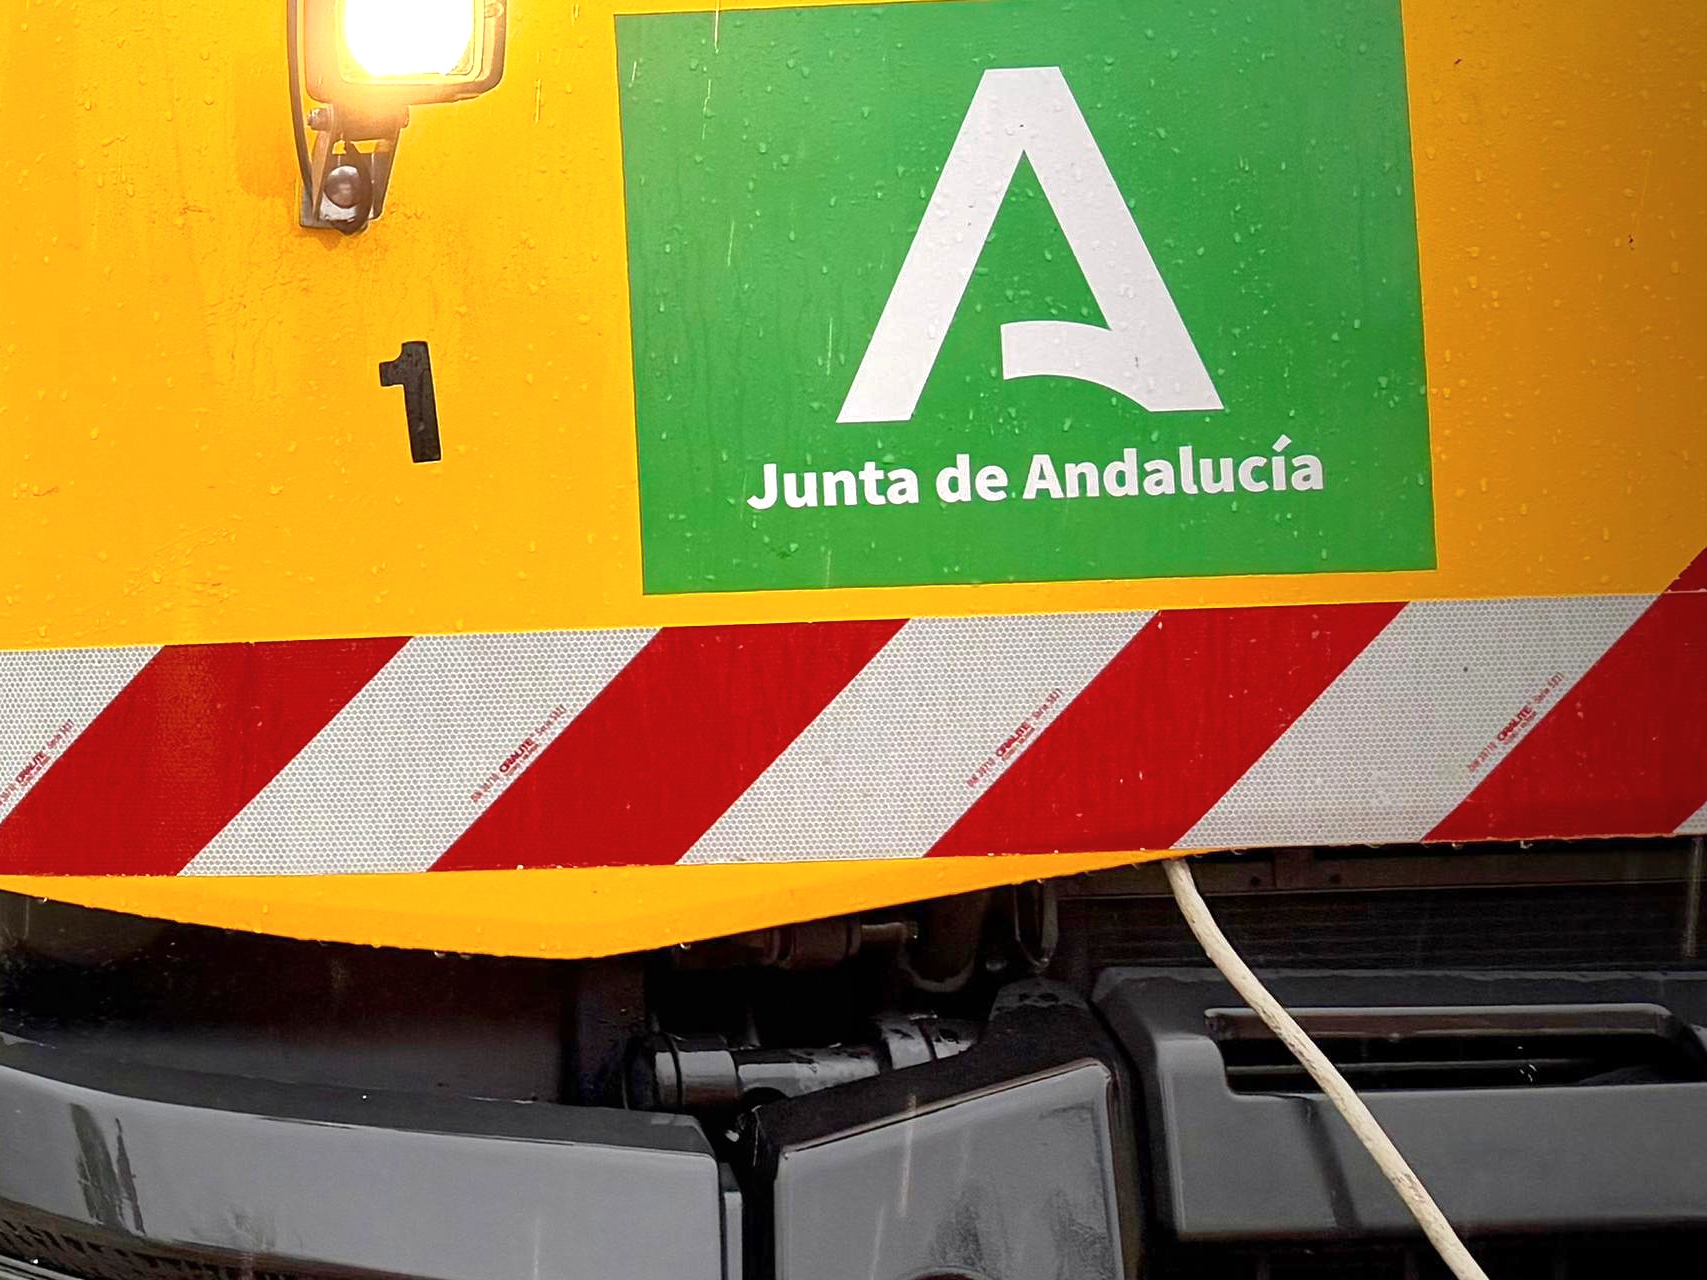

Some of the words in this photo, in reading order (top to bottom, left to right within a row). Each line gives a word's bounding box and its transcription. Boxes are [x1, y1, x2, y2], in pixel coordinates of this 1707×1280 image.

[378, 340, 441, 463] 1
[746, 461, 920, 510] Junta
[936, 454, 1008, 503] de
[1022, 434, 1323, 500] Andalucía
